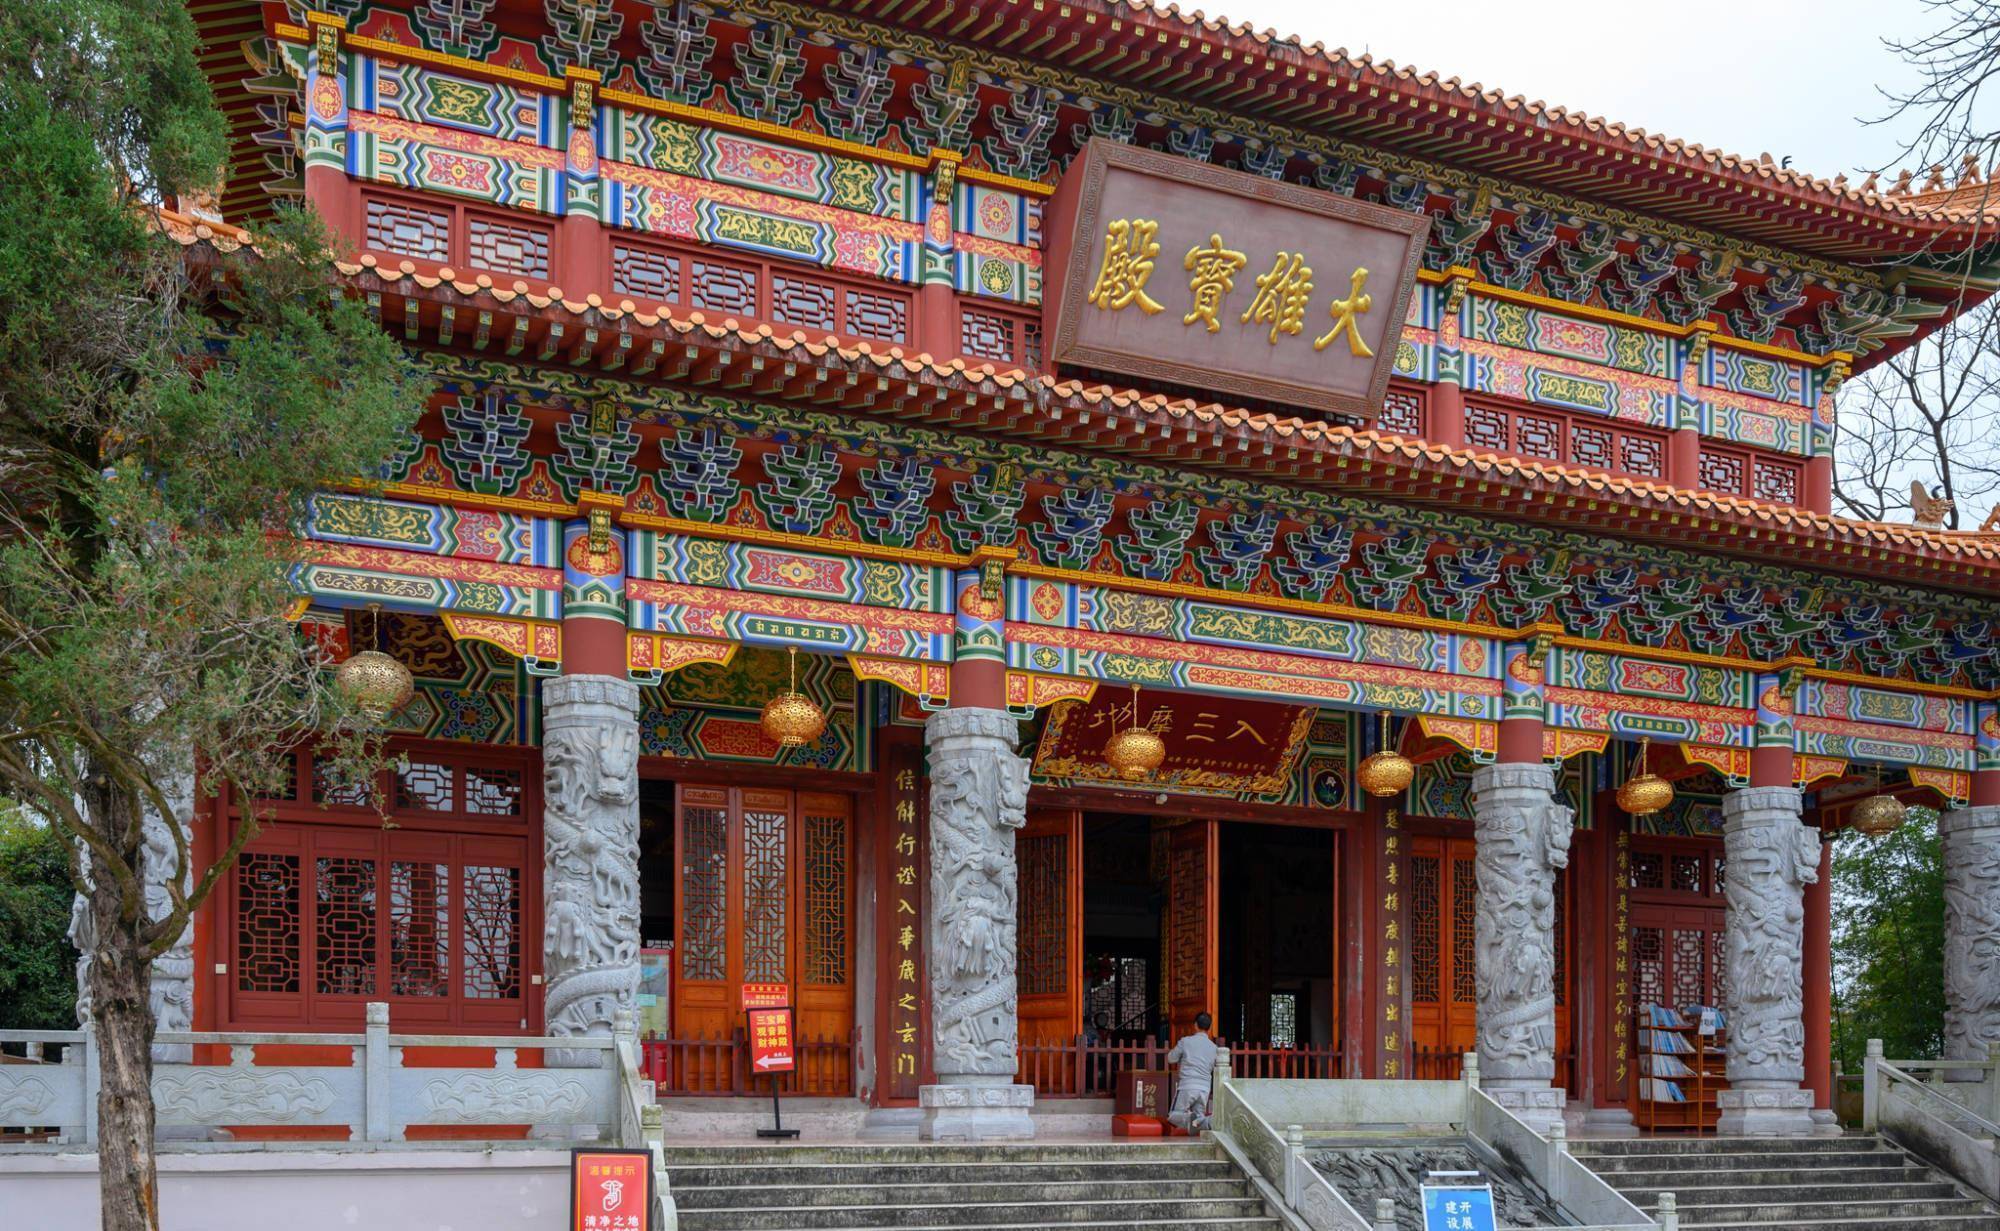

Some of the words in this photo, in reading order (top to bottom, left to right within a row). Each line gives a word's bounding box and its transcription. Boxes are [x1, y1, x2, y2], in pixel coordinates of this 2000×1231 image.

[1088, 218, 1373, 357] 大雄寶殿
[756, 1014, 786, 1026] 三宝殿
[756, 1025, 787, 1037] 观音殿
[757, 1036, 788, 1048] 财神殿
[584, 1215, 639, 1227] 清净之地
